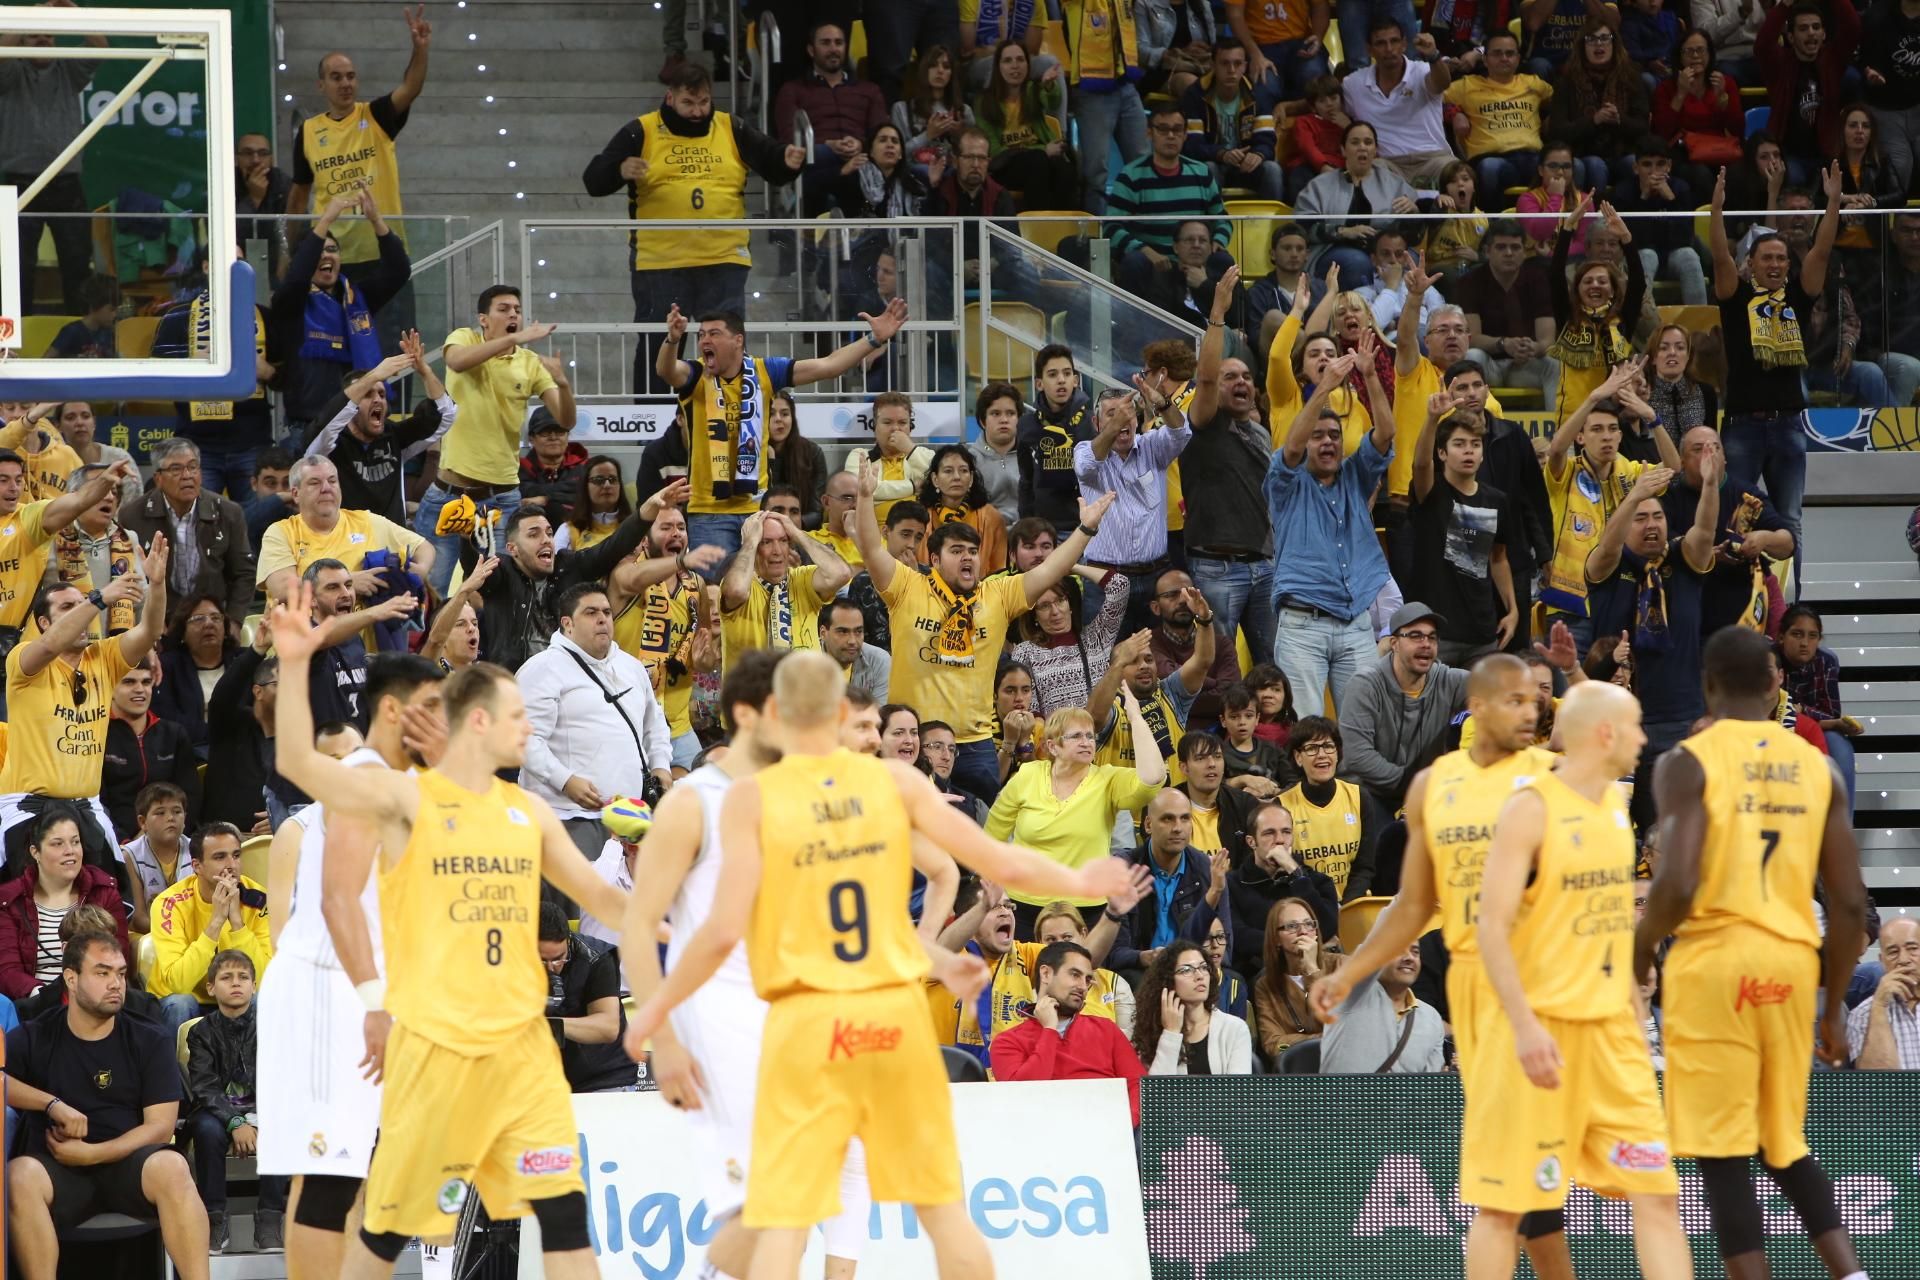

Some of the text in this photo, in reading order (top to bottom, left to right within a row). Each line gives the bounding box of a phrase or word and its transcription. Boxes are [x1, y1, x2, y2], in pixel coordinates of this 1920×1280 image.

[79, 81, 198, 126] eror
[1479, 101, 1534, 114] HERBALIFE
[314, 146, 376, 172] HERBALIFE
[664, 154, 722, 165] Canaria
[672, 144, 713, 155] Gran
[331, 166, 366, 182] Gran
[680, 165, 712, 174] 2014
[326, 175, 374, 196] Canaa
[691, 187, 705, 210] 6
[138, 428, 175, 440] Cabil
[1315, 859, 1347, 874] Gran
[1760, 829, 1781, 903] 7
[463, 877, 517, 903] Gran
[828, 879, 869, 963] 9
[486, 928, 502, 966] 8
[1601, 938, 1614, 977] 4
